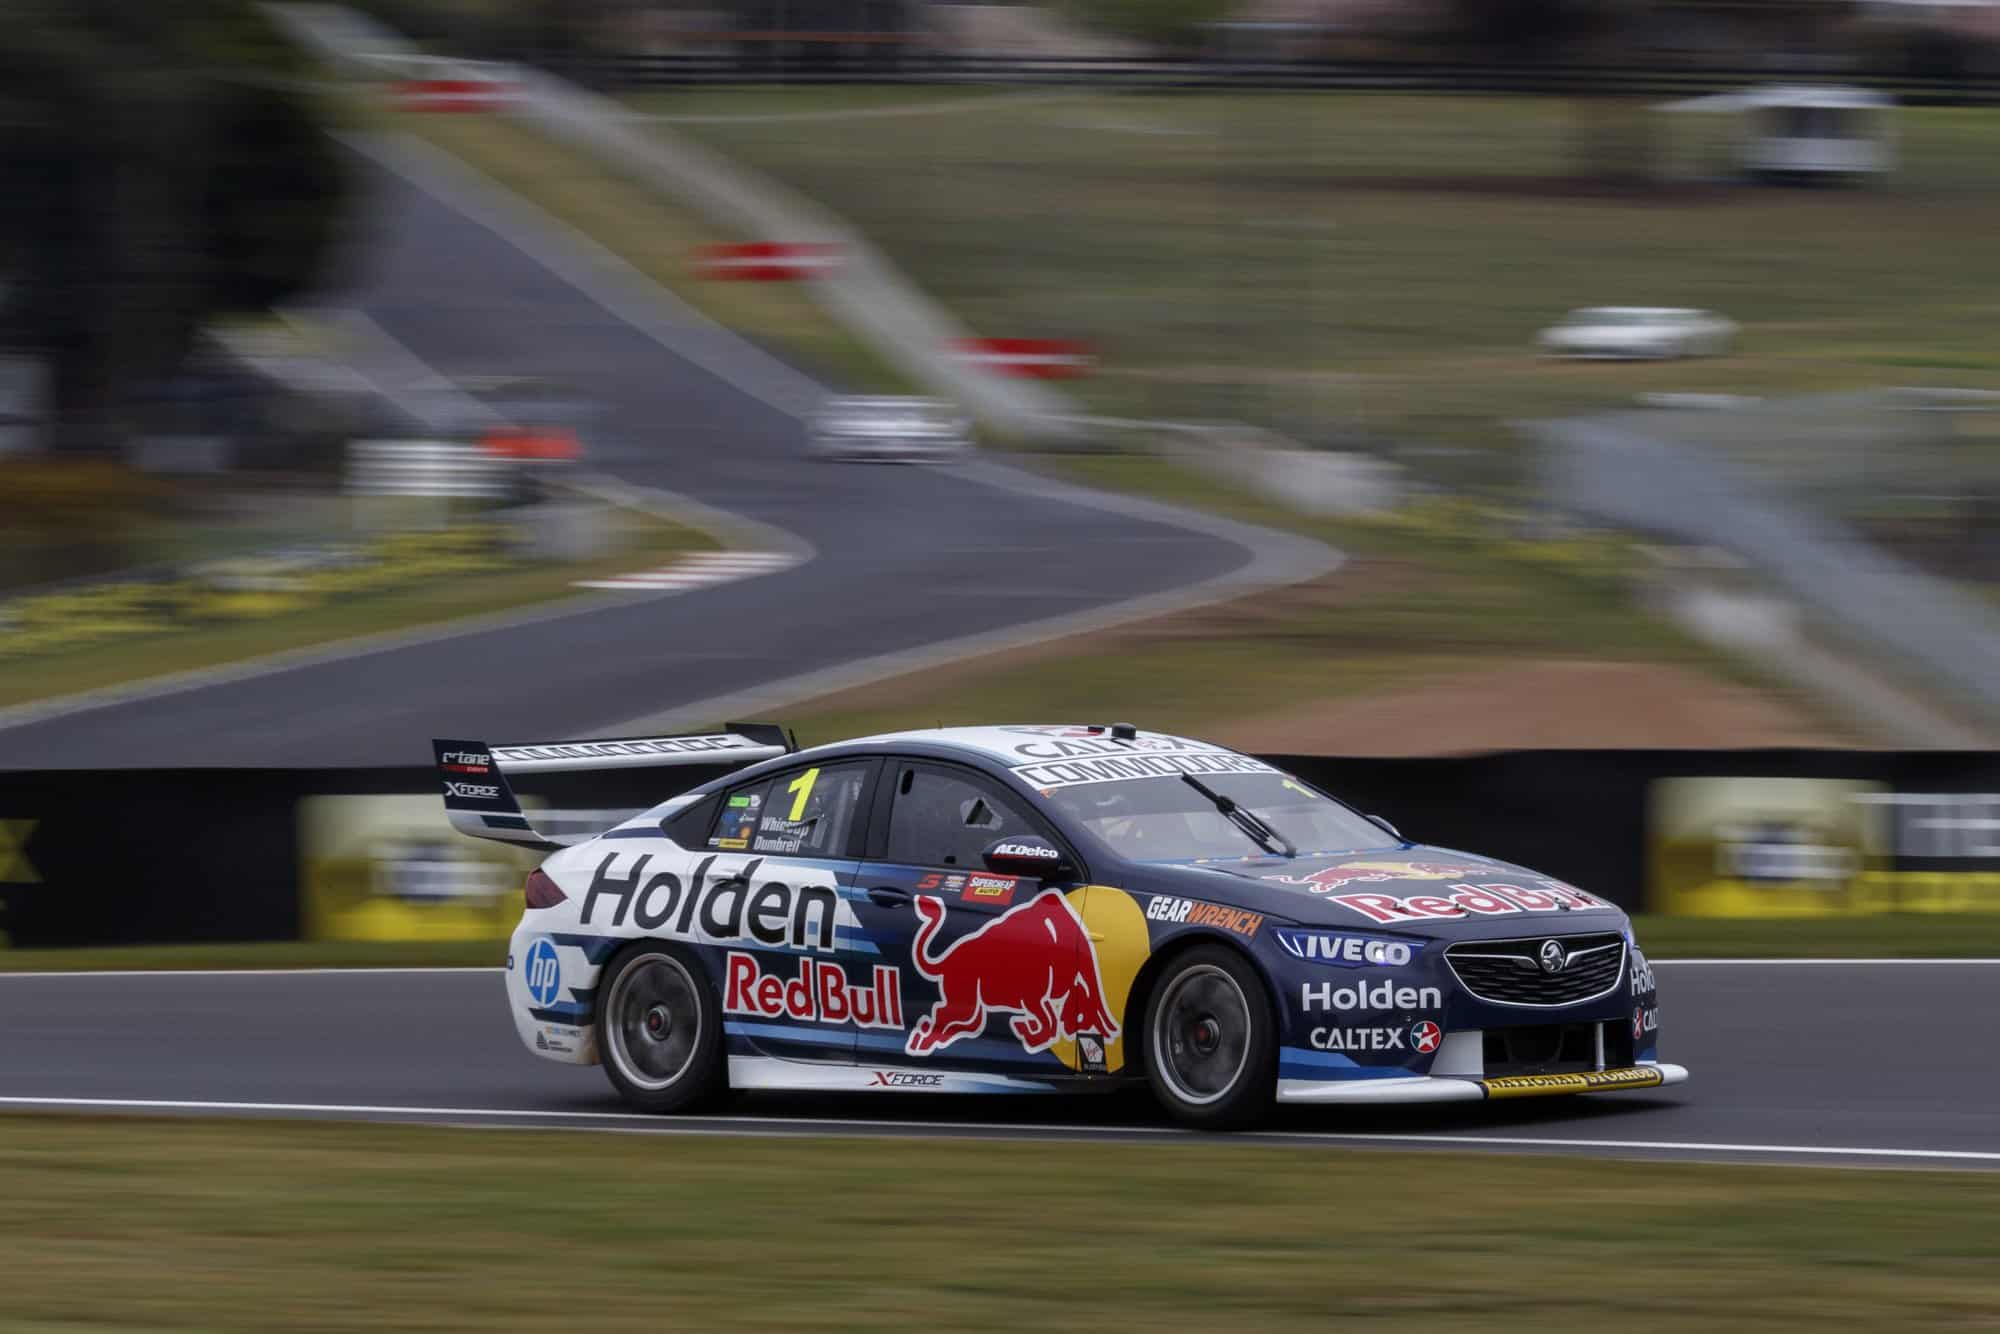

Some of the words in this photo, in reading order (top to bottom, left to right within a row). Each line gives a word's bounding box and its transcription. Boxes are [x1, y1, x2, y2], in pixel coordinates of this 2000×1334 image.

[788, 768, 820, 821] 1
[993, 843, 1059, 859] ACDelco
[580, 851, 834, 950] Holden
[1306, 936, 1412, 966] IVECO
[1302, 979, 1442, 1012] Holden
[1310, 1027, 1405, 1051] CALTEX
